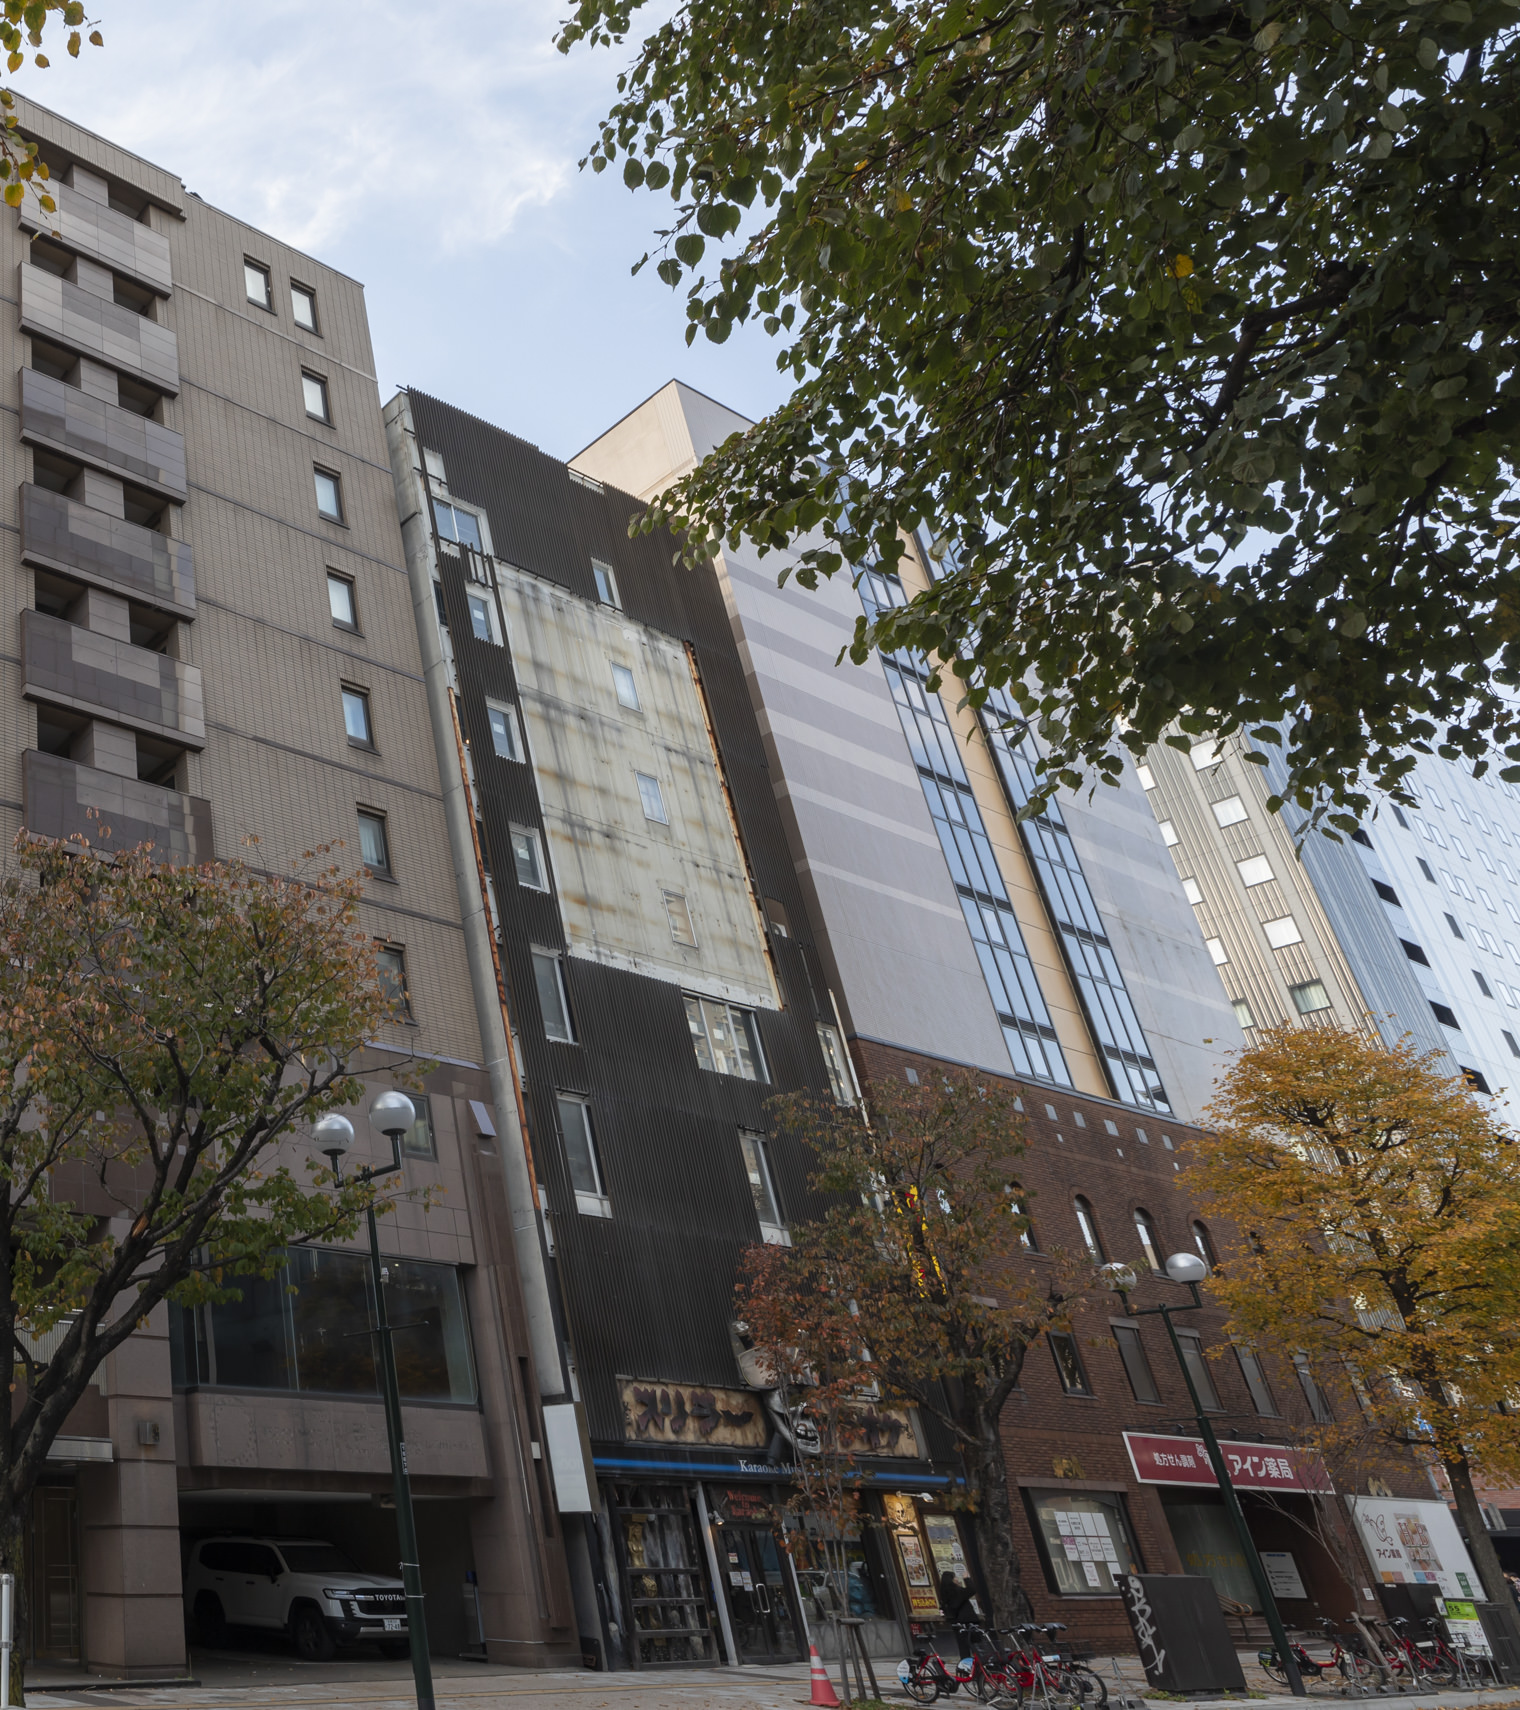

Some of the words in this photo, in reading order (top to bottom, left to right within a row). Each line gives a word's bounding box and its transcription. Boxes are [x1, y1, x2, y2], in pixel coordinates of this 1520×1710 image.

[1153, 1452, 1196, 1469] 処方せん調剤
[1228, 1454, 1294, 1480] アイン薬局
